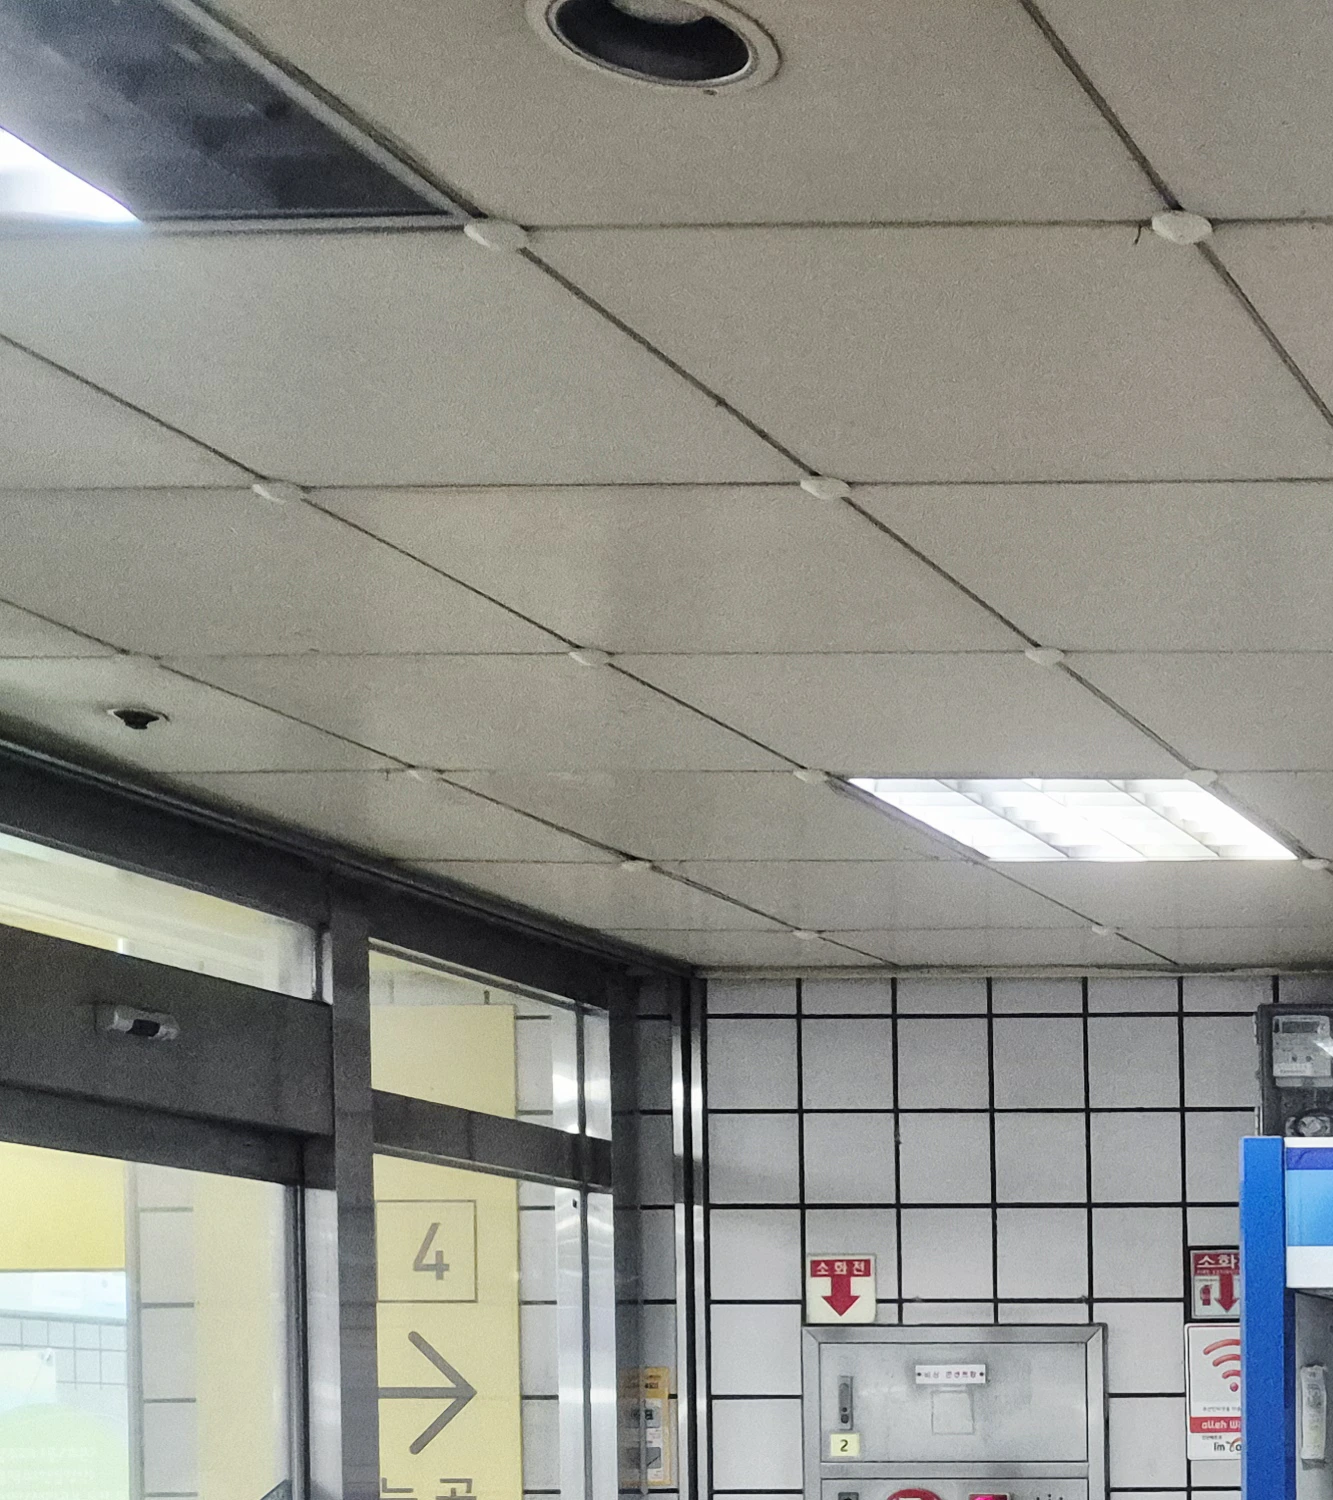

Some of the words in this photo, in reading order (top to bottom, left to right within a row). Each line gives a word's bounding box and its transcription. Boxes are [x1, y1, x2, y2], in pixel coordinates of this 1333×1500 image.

[412, 1222, 451, 1282] 4
[816, 1261, 865, 1275] 소화전
[1198, 1254, 1240, 1270] 소화
[840, 1439, 849, 1452] 2
